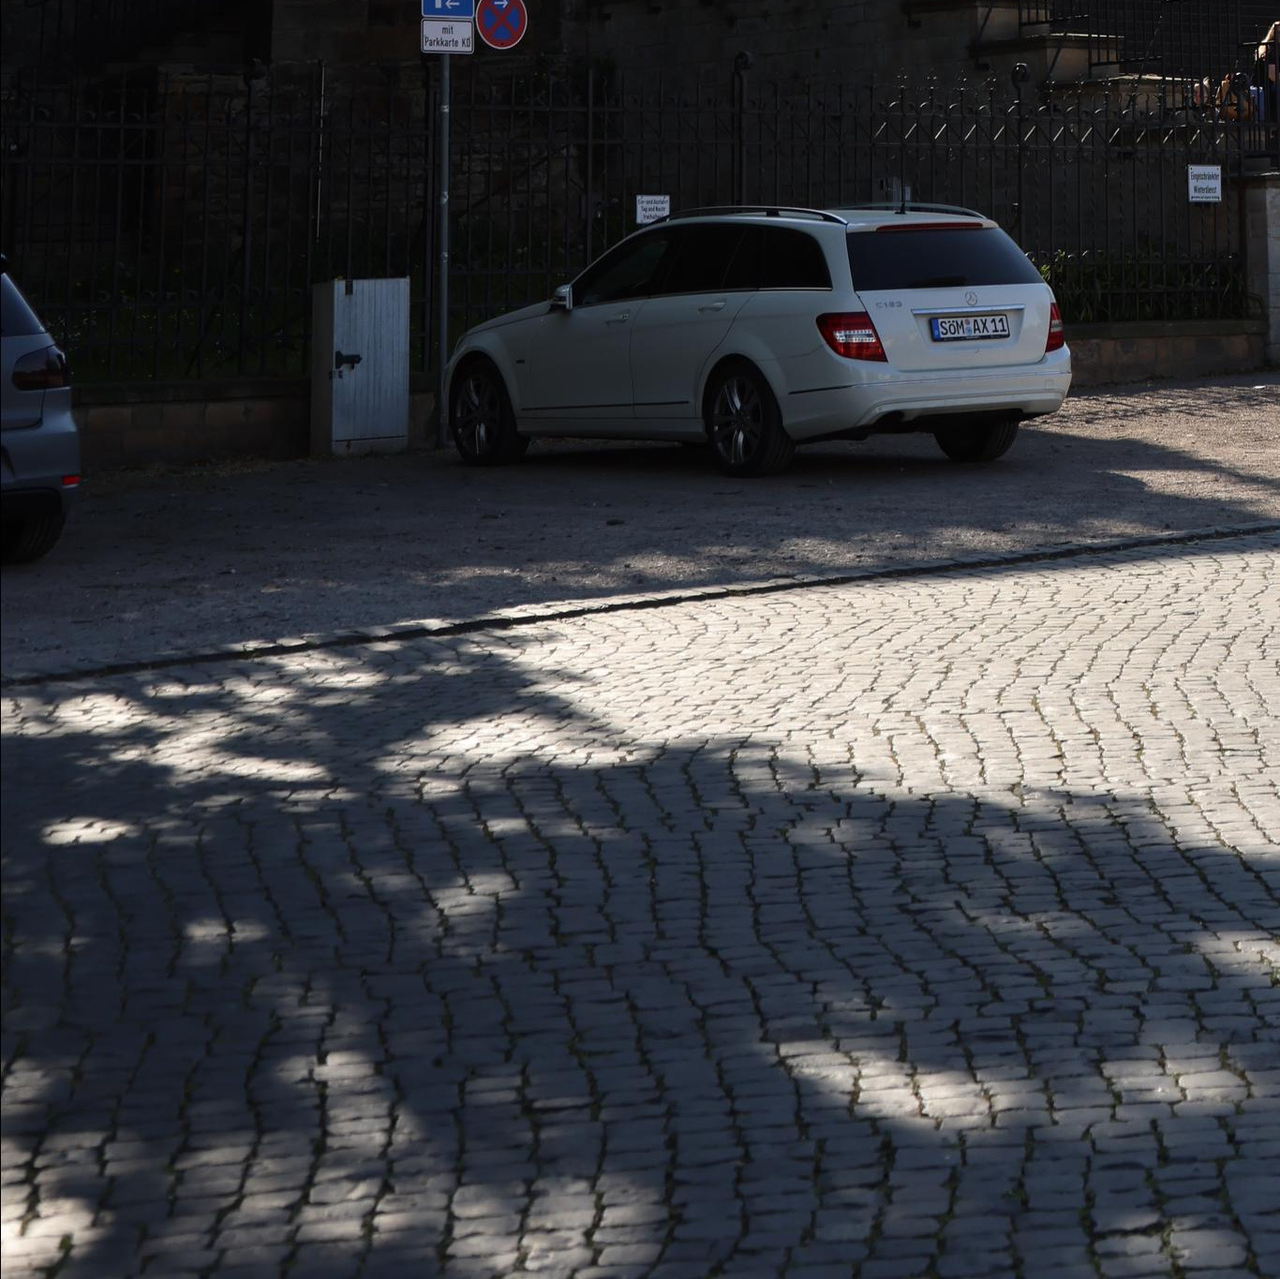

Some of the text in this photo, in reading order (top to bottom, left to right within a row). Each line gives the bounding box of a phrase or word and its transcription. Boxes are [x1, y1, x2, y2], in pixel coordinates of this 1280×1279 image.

[442, 25, 454, 35] mit
[425, 36, 459, 47] Parkkarte
[973, 318, 988, 334] AX
[991, 317, 1007, 333] 11
